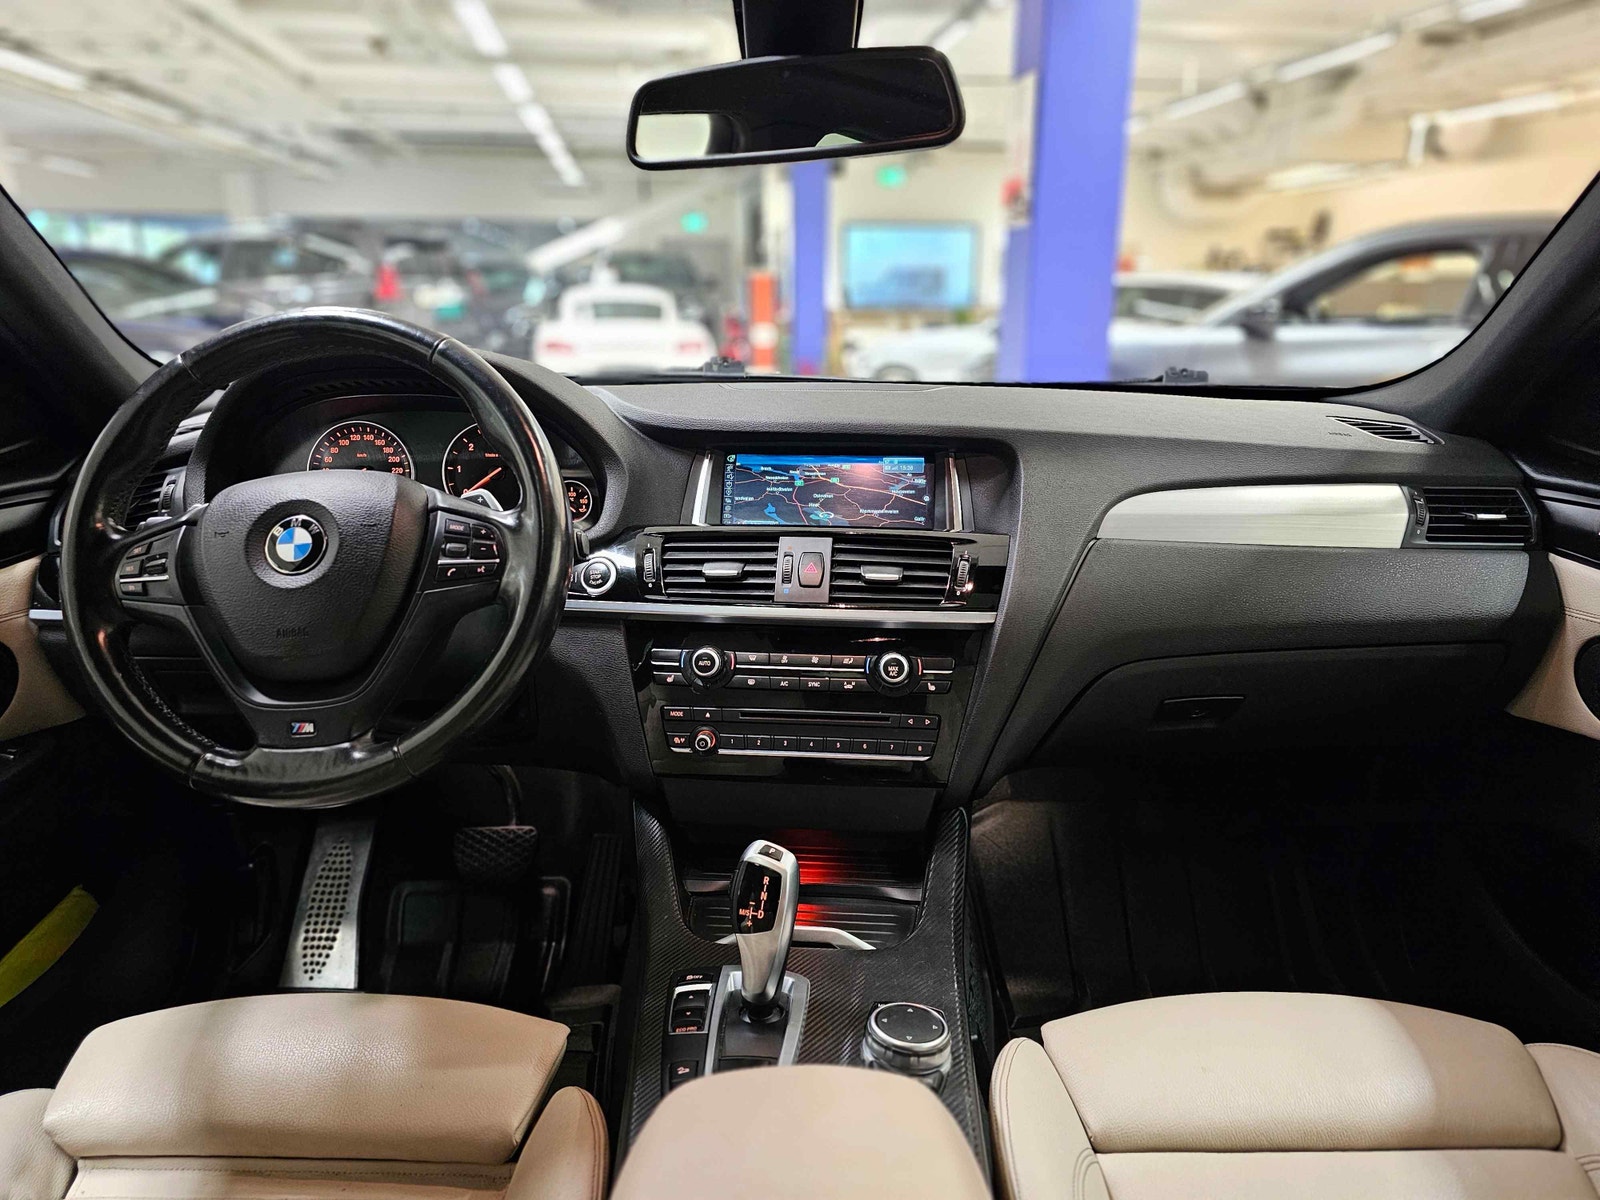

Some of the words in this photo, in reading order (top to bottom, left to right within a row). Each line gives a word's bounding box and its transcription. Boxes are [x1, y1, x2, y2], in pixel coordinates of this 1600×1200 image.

[468, 443, 475, 451] 2
[456, 465, 461, 473] 1
[273, 518, 320, 537] BMW
[763, 876, 770, 885] R
[761, 891, 768, 901] N
[757, 909, 765, 919] D
